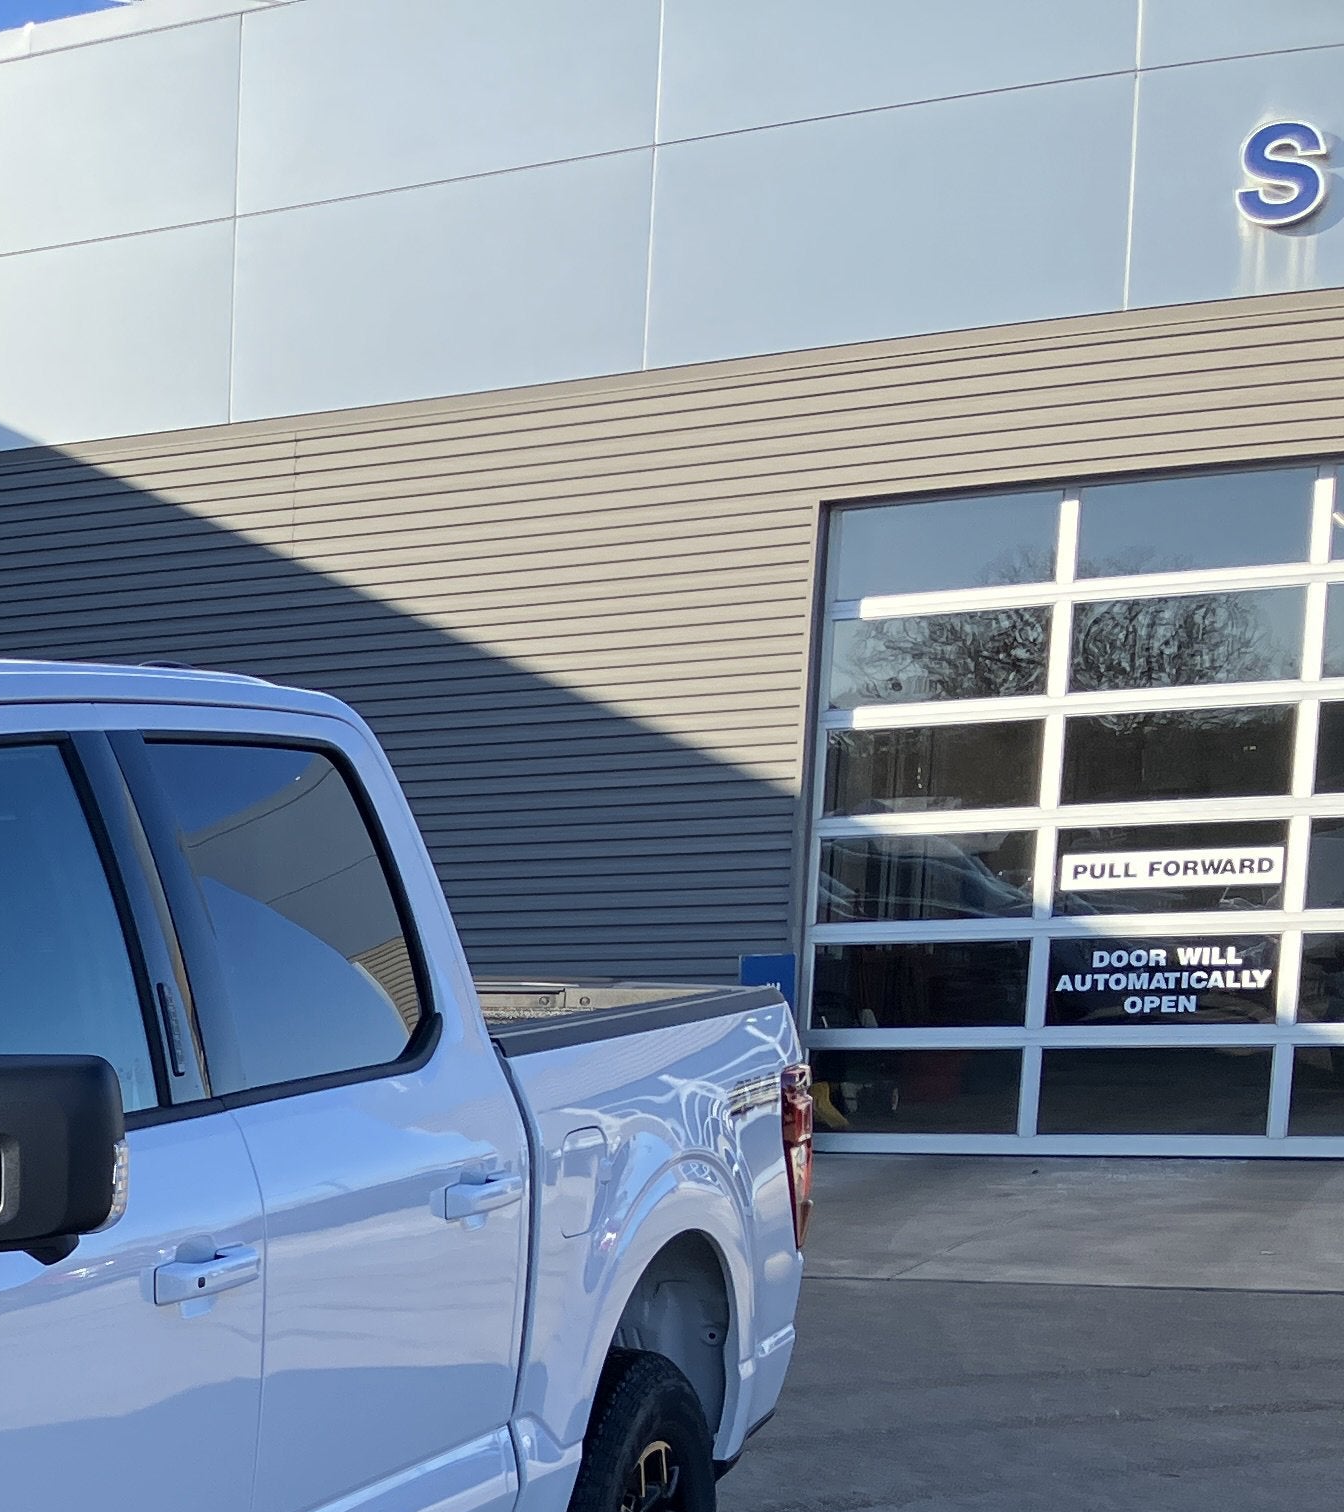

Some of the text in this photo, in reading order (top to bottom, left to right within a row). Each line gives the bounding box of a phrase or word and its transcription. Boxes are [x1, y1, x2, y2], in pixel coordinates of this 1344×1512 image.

[1235, 120, 1328, 226] S
[1072, 857, 1275, 880] PULL FORWARD
[1092, 946, 1243, 969] DOOR WILL
[1055, 969, 1272, 992] AUTOMATICALLY
[1123, 995, 1197, 1014] OPEN
